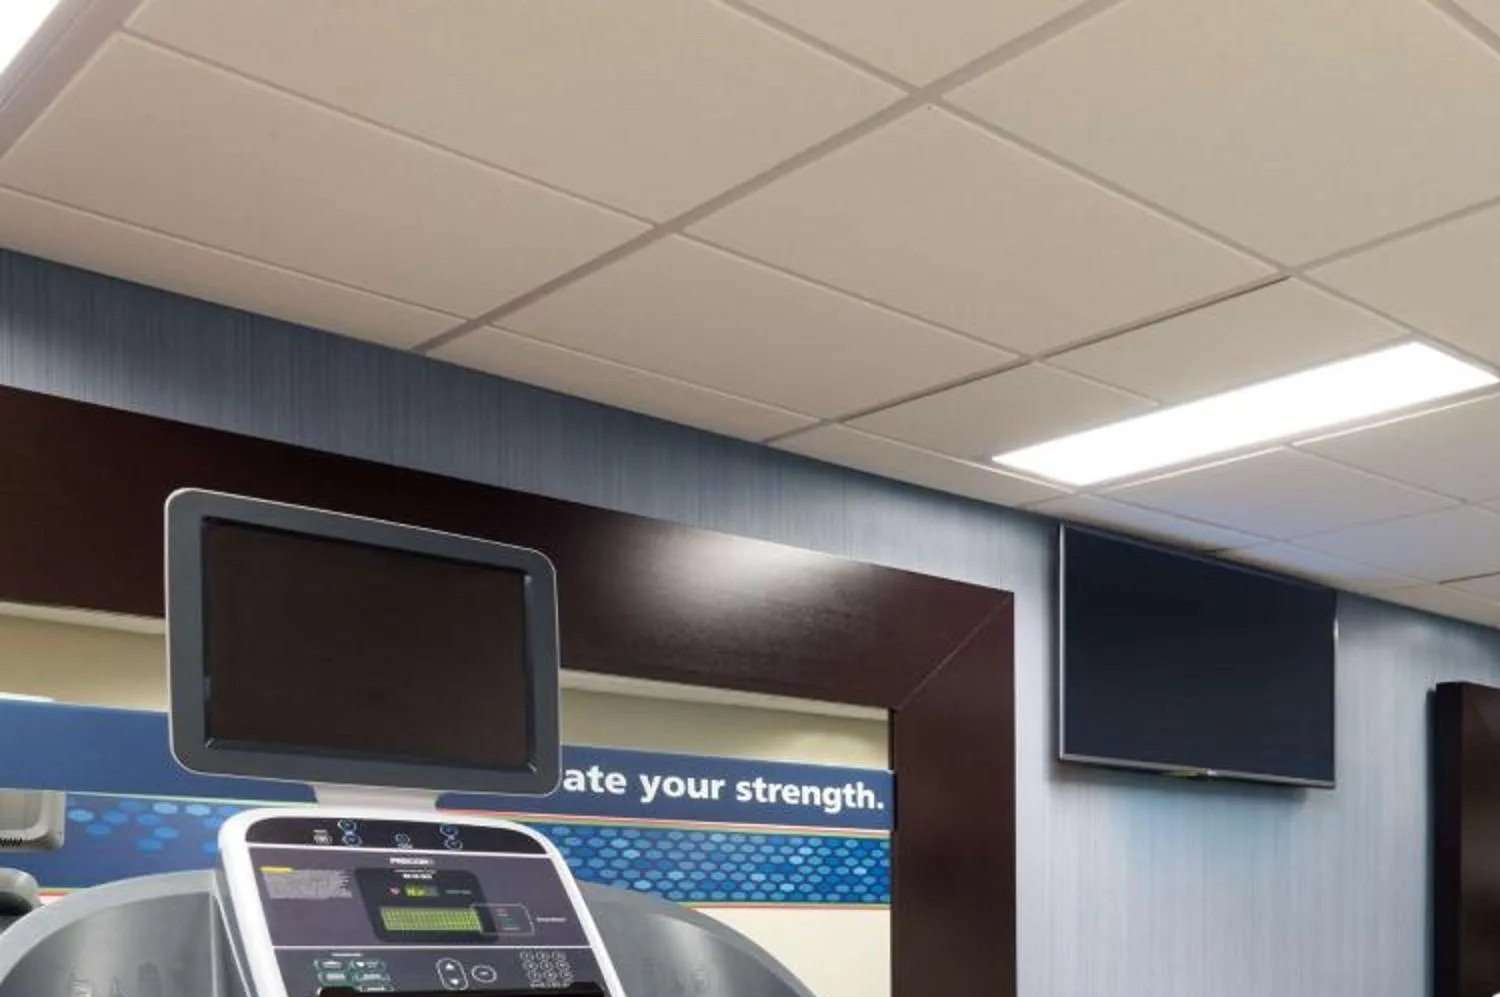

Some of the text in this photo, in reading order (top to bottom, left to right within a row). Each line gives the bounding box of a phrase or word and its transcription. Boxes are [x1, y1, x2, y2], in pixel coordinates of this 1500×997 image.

[563, 765, 885, 814] ate your strength.
